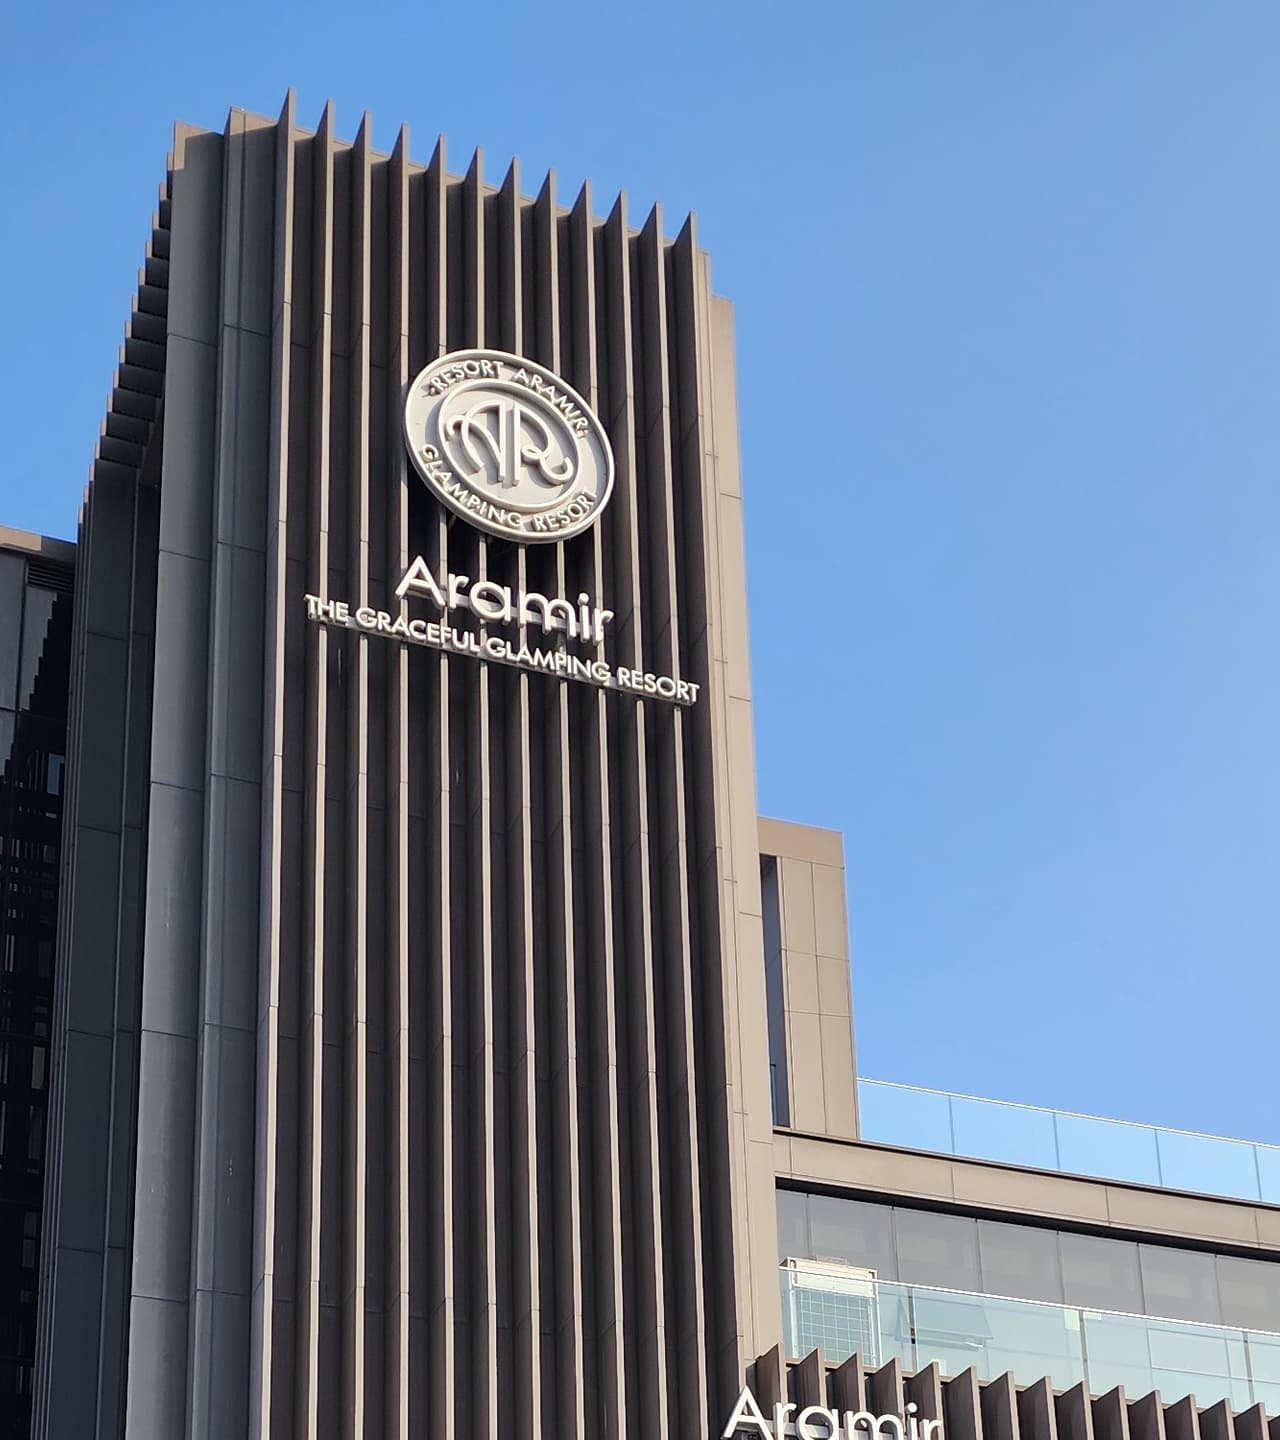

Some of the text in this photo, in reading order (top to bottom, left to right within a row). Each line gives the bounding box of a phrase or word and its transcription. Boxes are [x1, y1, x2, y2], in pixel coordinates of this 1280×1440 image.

[430, 359, 589, 435] RESORT ARAMIR
[423, 444, 597, 530] GLAMPING RESORT
[395, 555, 615, 645] Aramir
[304, 594, 700, 704] THE GRACEFUL GLAMPING RESORT
